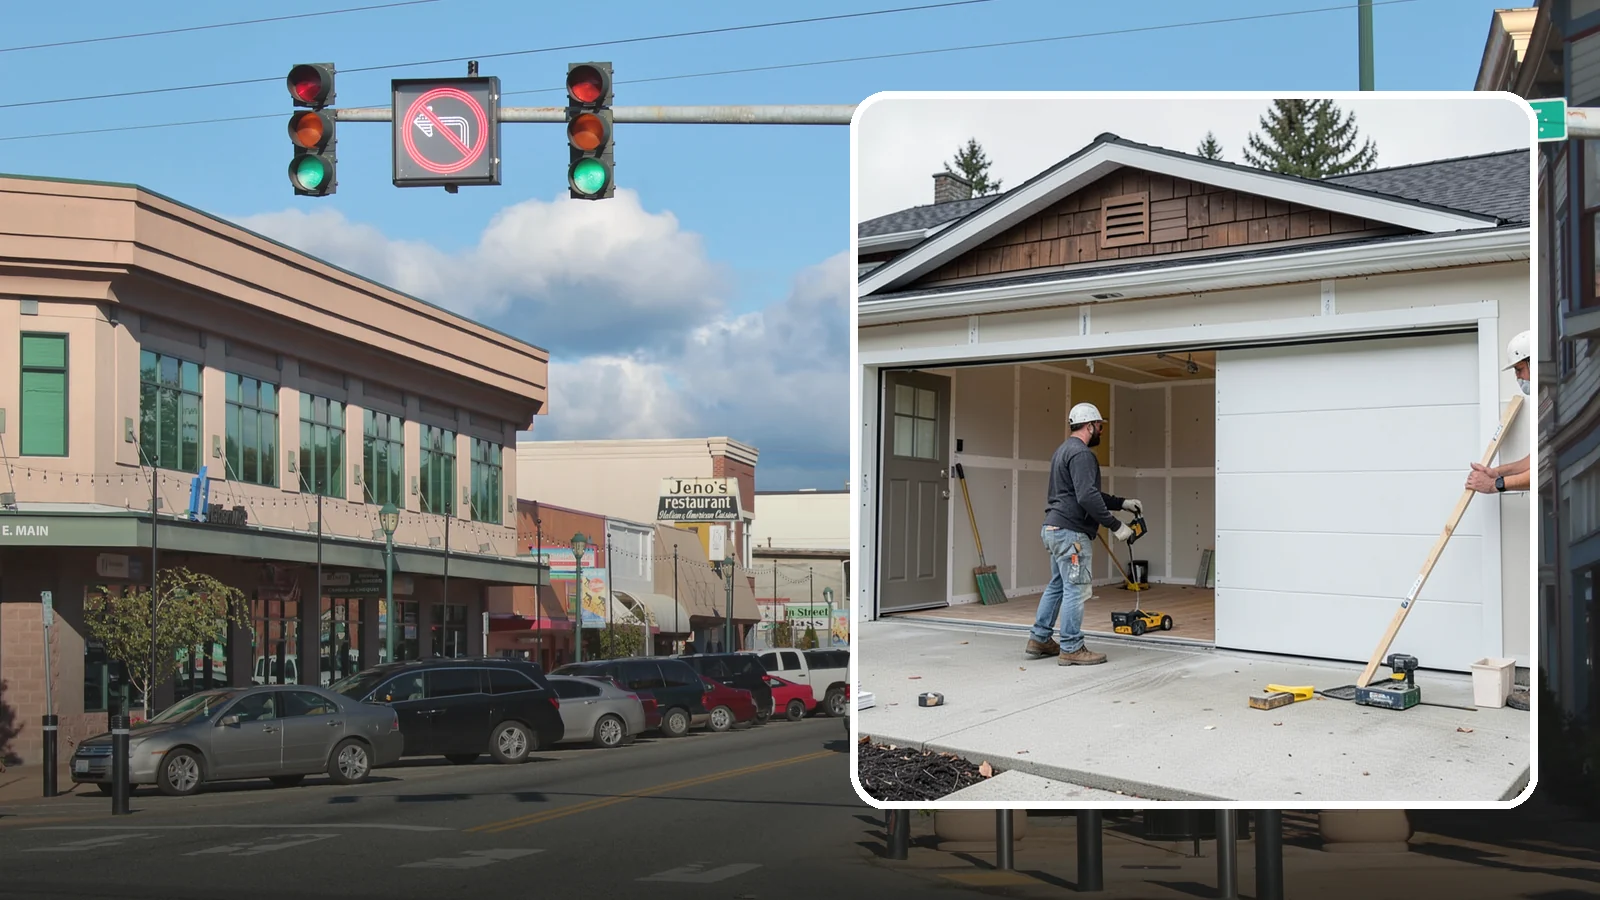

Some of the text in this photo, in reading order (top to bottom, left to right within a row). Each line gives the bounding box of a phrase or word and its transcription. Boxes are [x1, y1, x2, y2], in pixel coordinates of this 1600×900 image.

[670, 480, 727, 494] Jeno's
[665, 496, 731, 509] restaurant
[659, 510, 682, 519] Italian
[686, 510, 714, 519] American
[715, 510, 737, 519] Cuisine
[2, 525, 49, 536] E. MAIN
[797, 608, 829, 617] Street
[791, 619, 824, 627] lass
